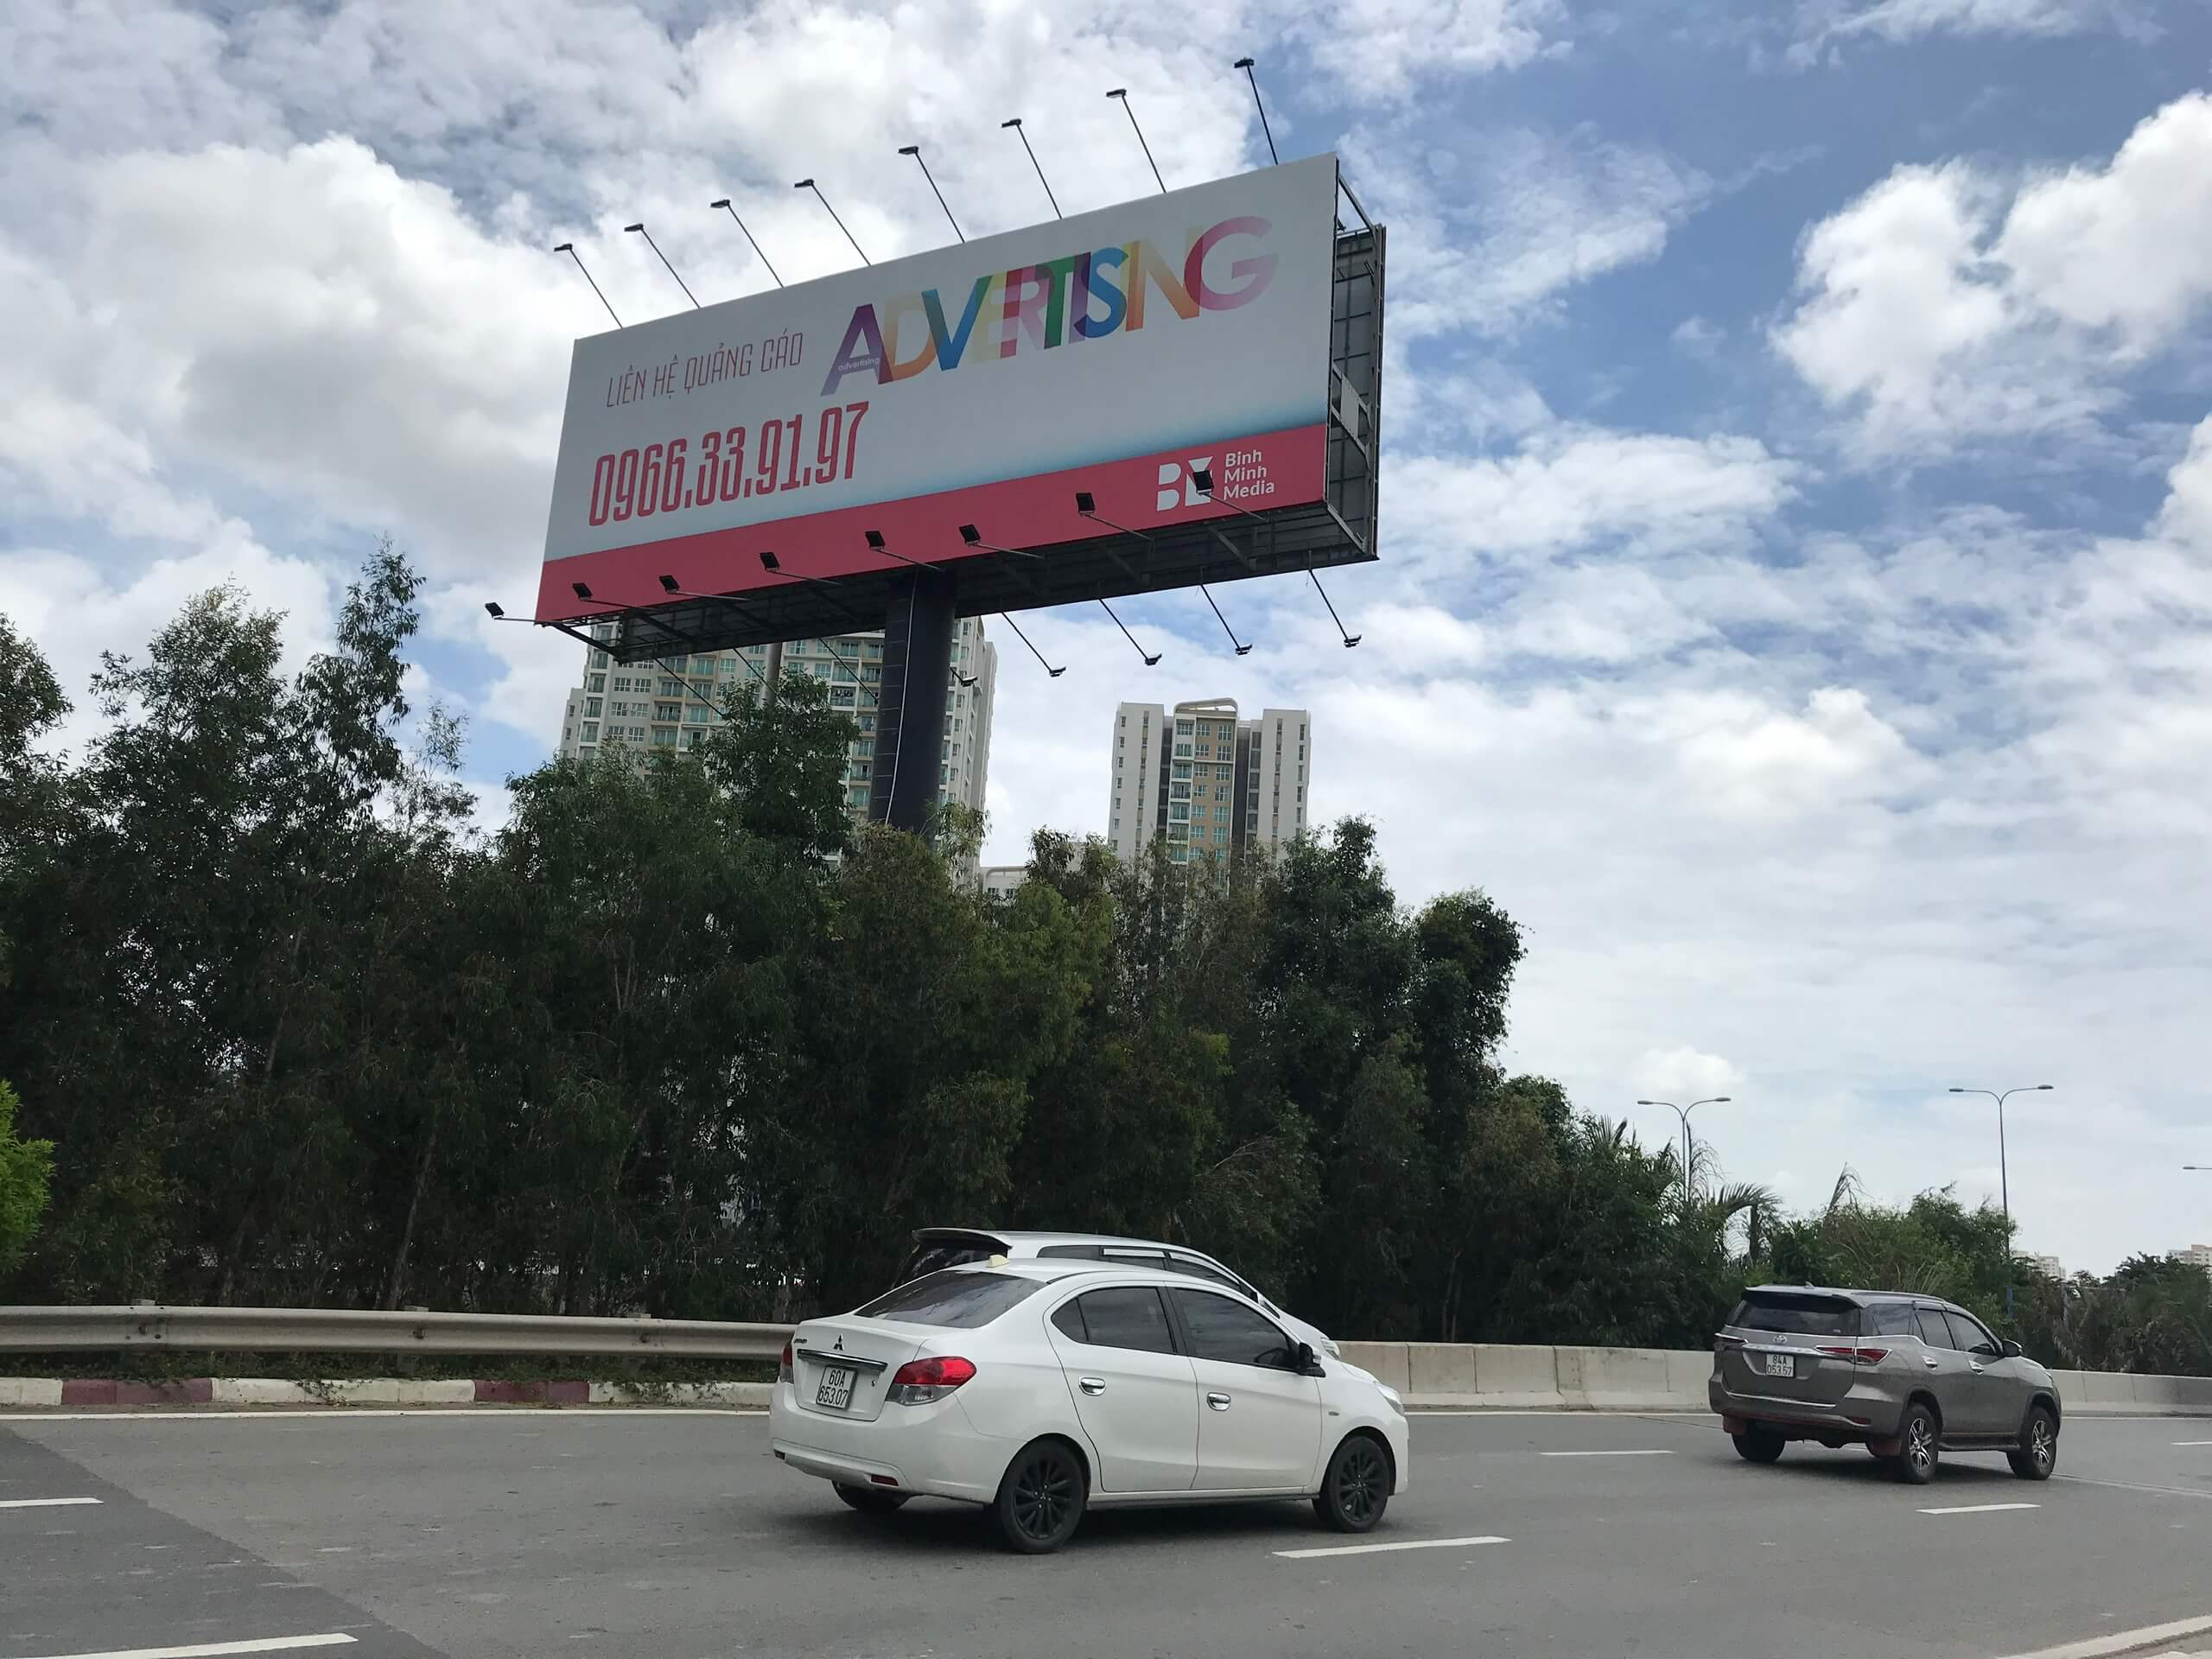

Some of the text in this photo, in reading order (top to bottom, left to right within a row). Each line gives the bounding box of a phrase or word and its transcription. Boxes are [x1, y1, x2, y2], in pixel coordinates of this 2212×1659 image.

[607, 327, 804, 408] LIÊN HỆ QUẢNG CÁO
[588, 401, 869, 527] 0966.33.91.97
[1224, 448, 1262, 467] Binh
[1224, 465, 1267, 484] Minh
[1223, 480, 1275, 501] Media
[1772, 1354, 1788, 1365] 84A
[829, 1370, 846, 1388] 60A
[817, 1385, 849, 1406] 653.07
